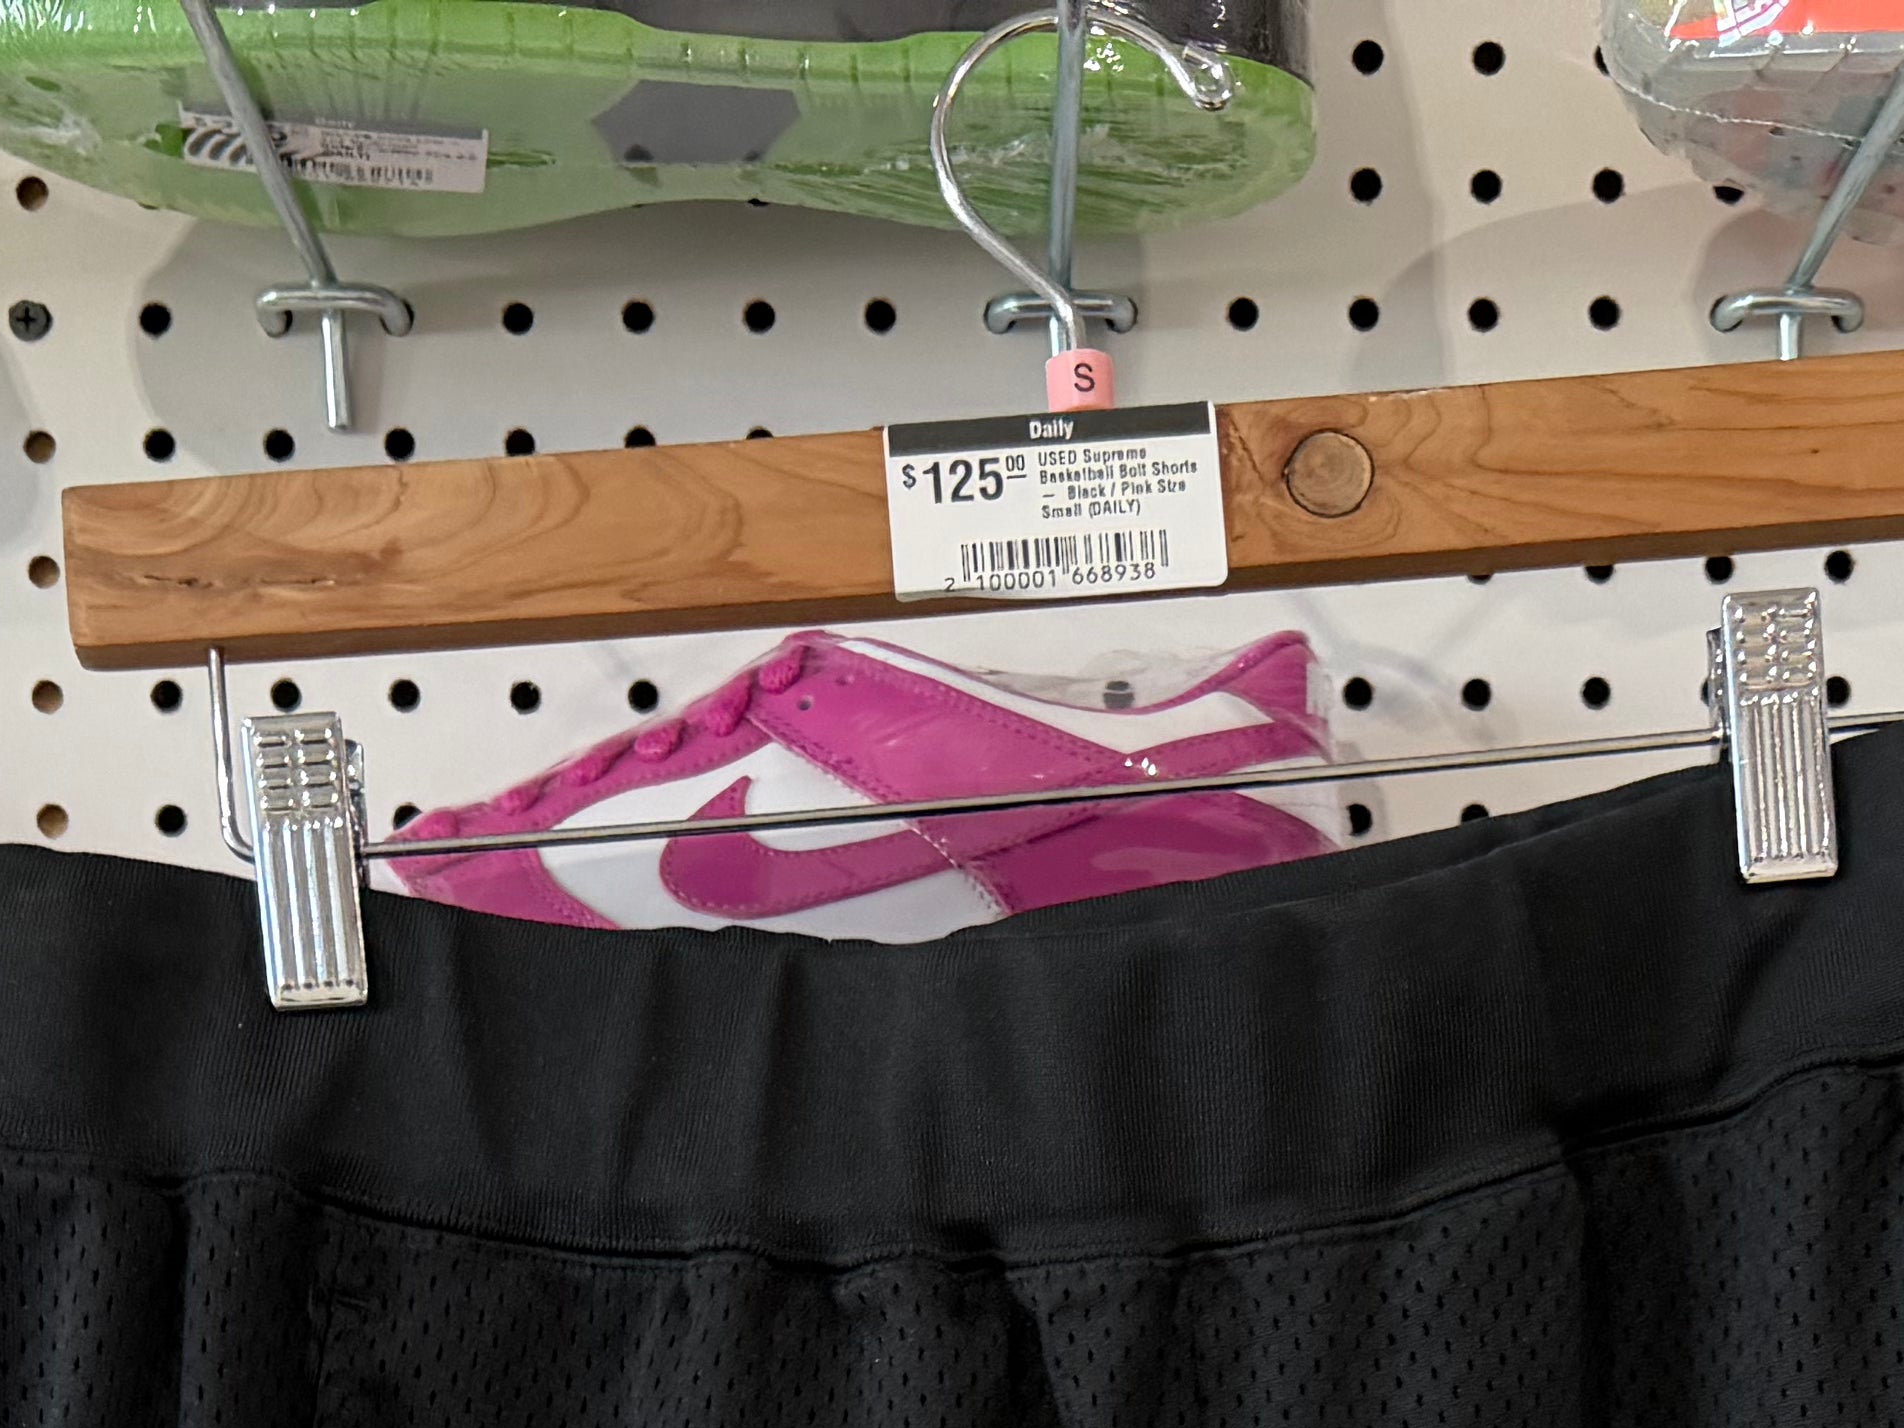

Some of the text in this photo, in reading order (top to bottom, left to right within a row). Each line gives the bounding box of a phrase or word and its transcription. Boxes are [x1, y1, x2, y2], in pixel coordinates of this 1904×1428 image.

[1073, 362, 1096, 393] S
[1029, 418, 1074, 440] Daily
[1038, 447, 1147, 466] USED Supreme
[1040, 460, 1198, 484] Basketball Bolt Shorts
[1067, 484, 1106, 500] Black
[1121, 479, 1152, 496] Pink
[1041, 498, 1141, 519] Small (DAILY)
[976, 568, 1057, 592] 100001
[1072, 561, 1156, 586] 668938
